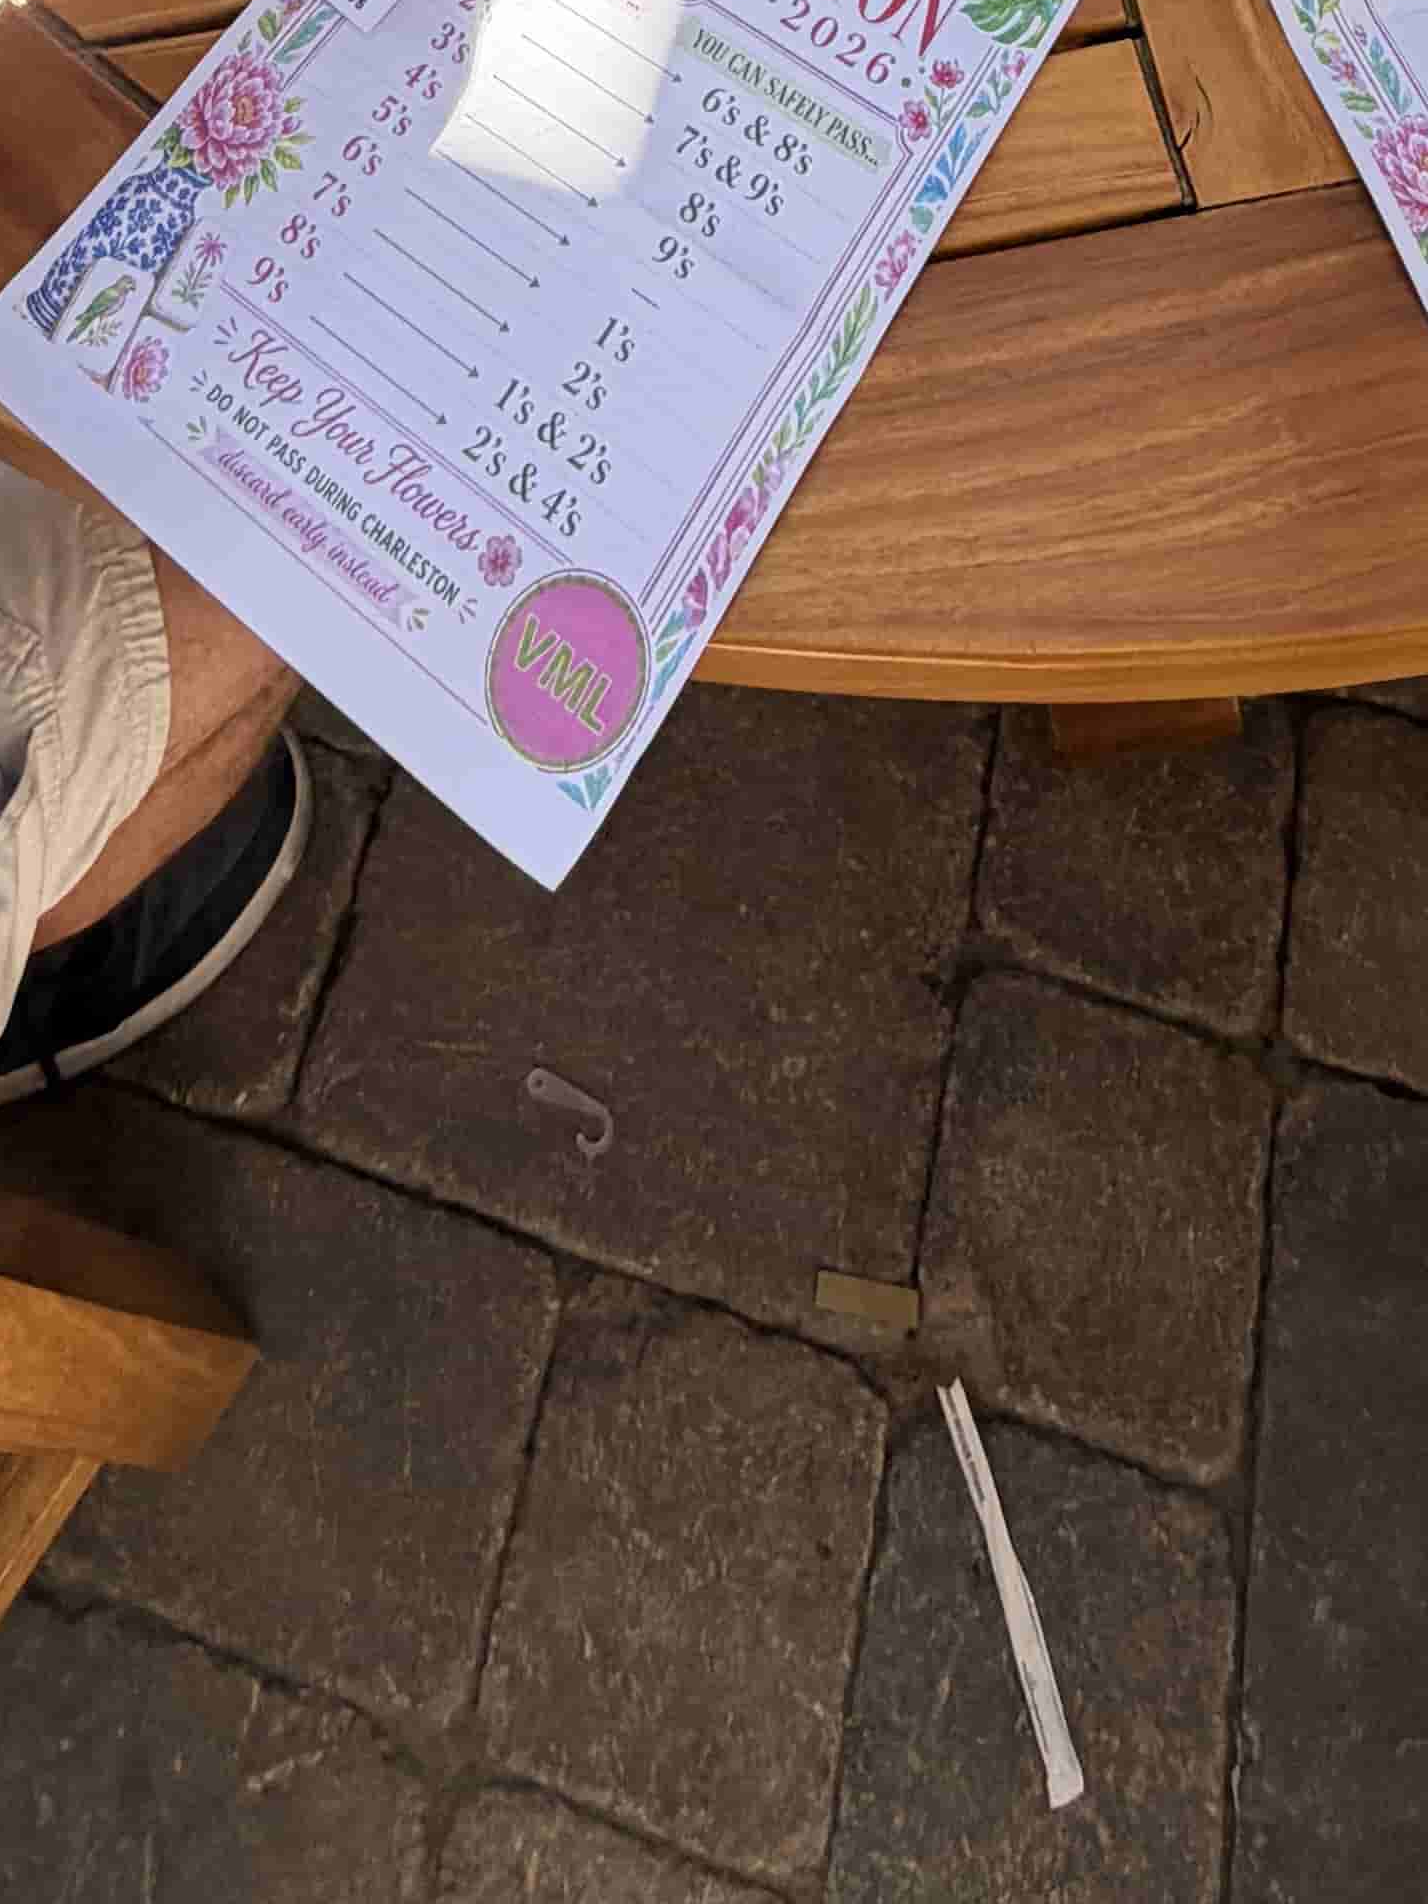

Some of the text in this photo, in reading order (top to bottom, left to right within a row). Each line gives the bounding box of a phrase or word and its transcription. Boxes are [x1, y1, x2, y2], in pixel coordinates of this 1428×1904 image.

[431, 22, 471, 65] 3's
[405, 62, 443, 101] 4's
[691, 28, 727, 71] YOU
[727, 50, 766, 89] CAN
[765, 71, 829, 131] SAFELY
[372, 95, 413, 137] 5's
[701, 86, 814, 176] 6's & 8's
[343, 135, 383, 177] 6's
[674, 125, 785, 218] 7's & 9's
[313, 171, 351, 217] 7's
[679, 190, 721, 239] 8's
[281, 212, 321, 259] 8's
[652, 235, 696, 281] 9's
[248, 255, 289, 303] 9's
[593, 316, 636, 364] 1's
[562, 359, 608, 411] 2's
[228, 328, 481, 552] Keep Your Flowers
[495, 376, 613, 487] 1's & 2's
[206, 383, 461, 608] DO NOT PASS DURING CHARLESTON
[462, 424, 582, 538] 2's & 4's
[218, 450, 401, 604] discard early instead
[513, 613, 613, 735] VML
